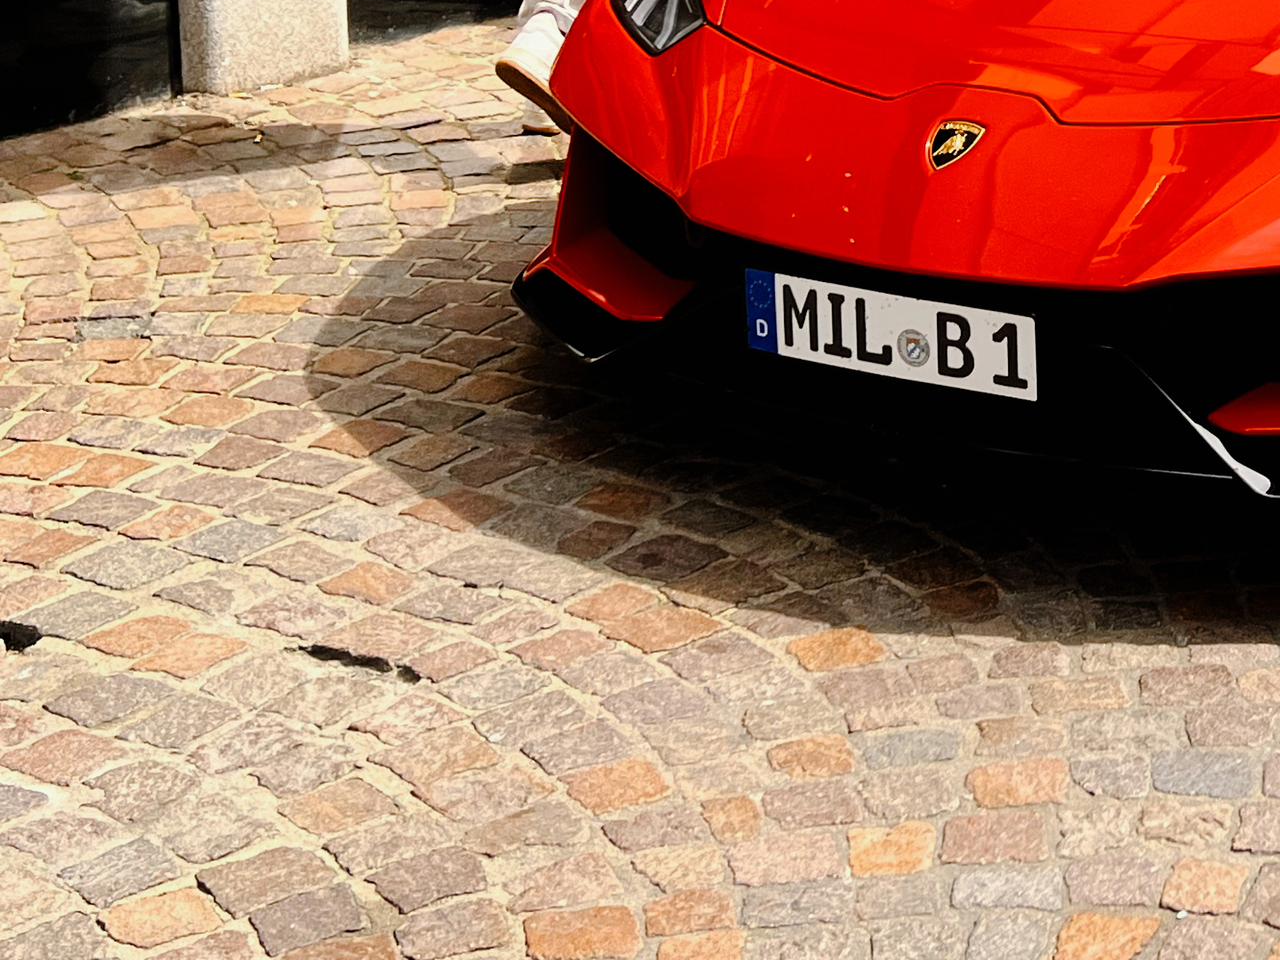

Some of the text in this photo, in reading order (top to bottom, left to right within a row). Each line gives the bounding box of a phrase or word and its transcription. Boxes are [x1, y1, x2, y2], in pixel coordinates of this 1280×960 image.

[756, 319, 768, 337] D
[782, 284, 1029, 389] MIL B 1
